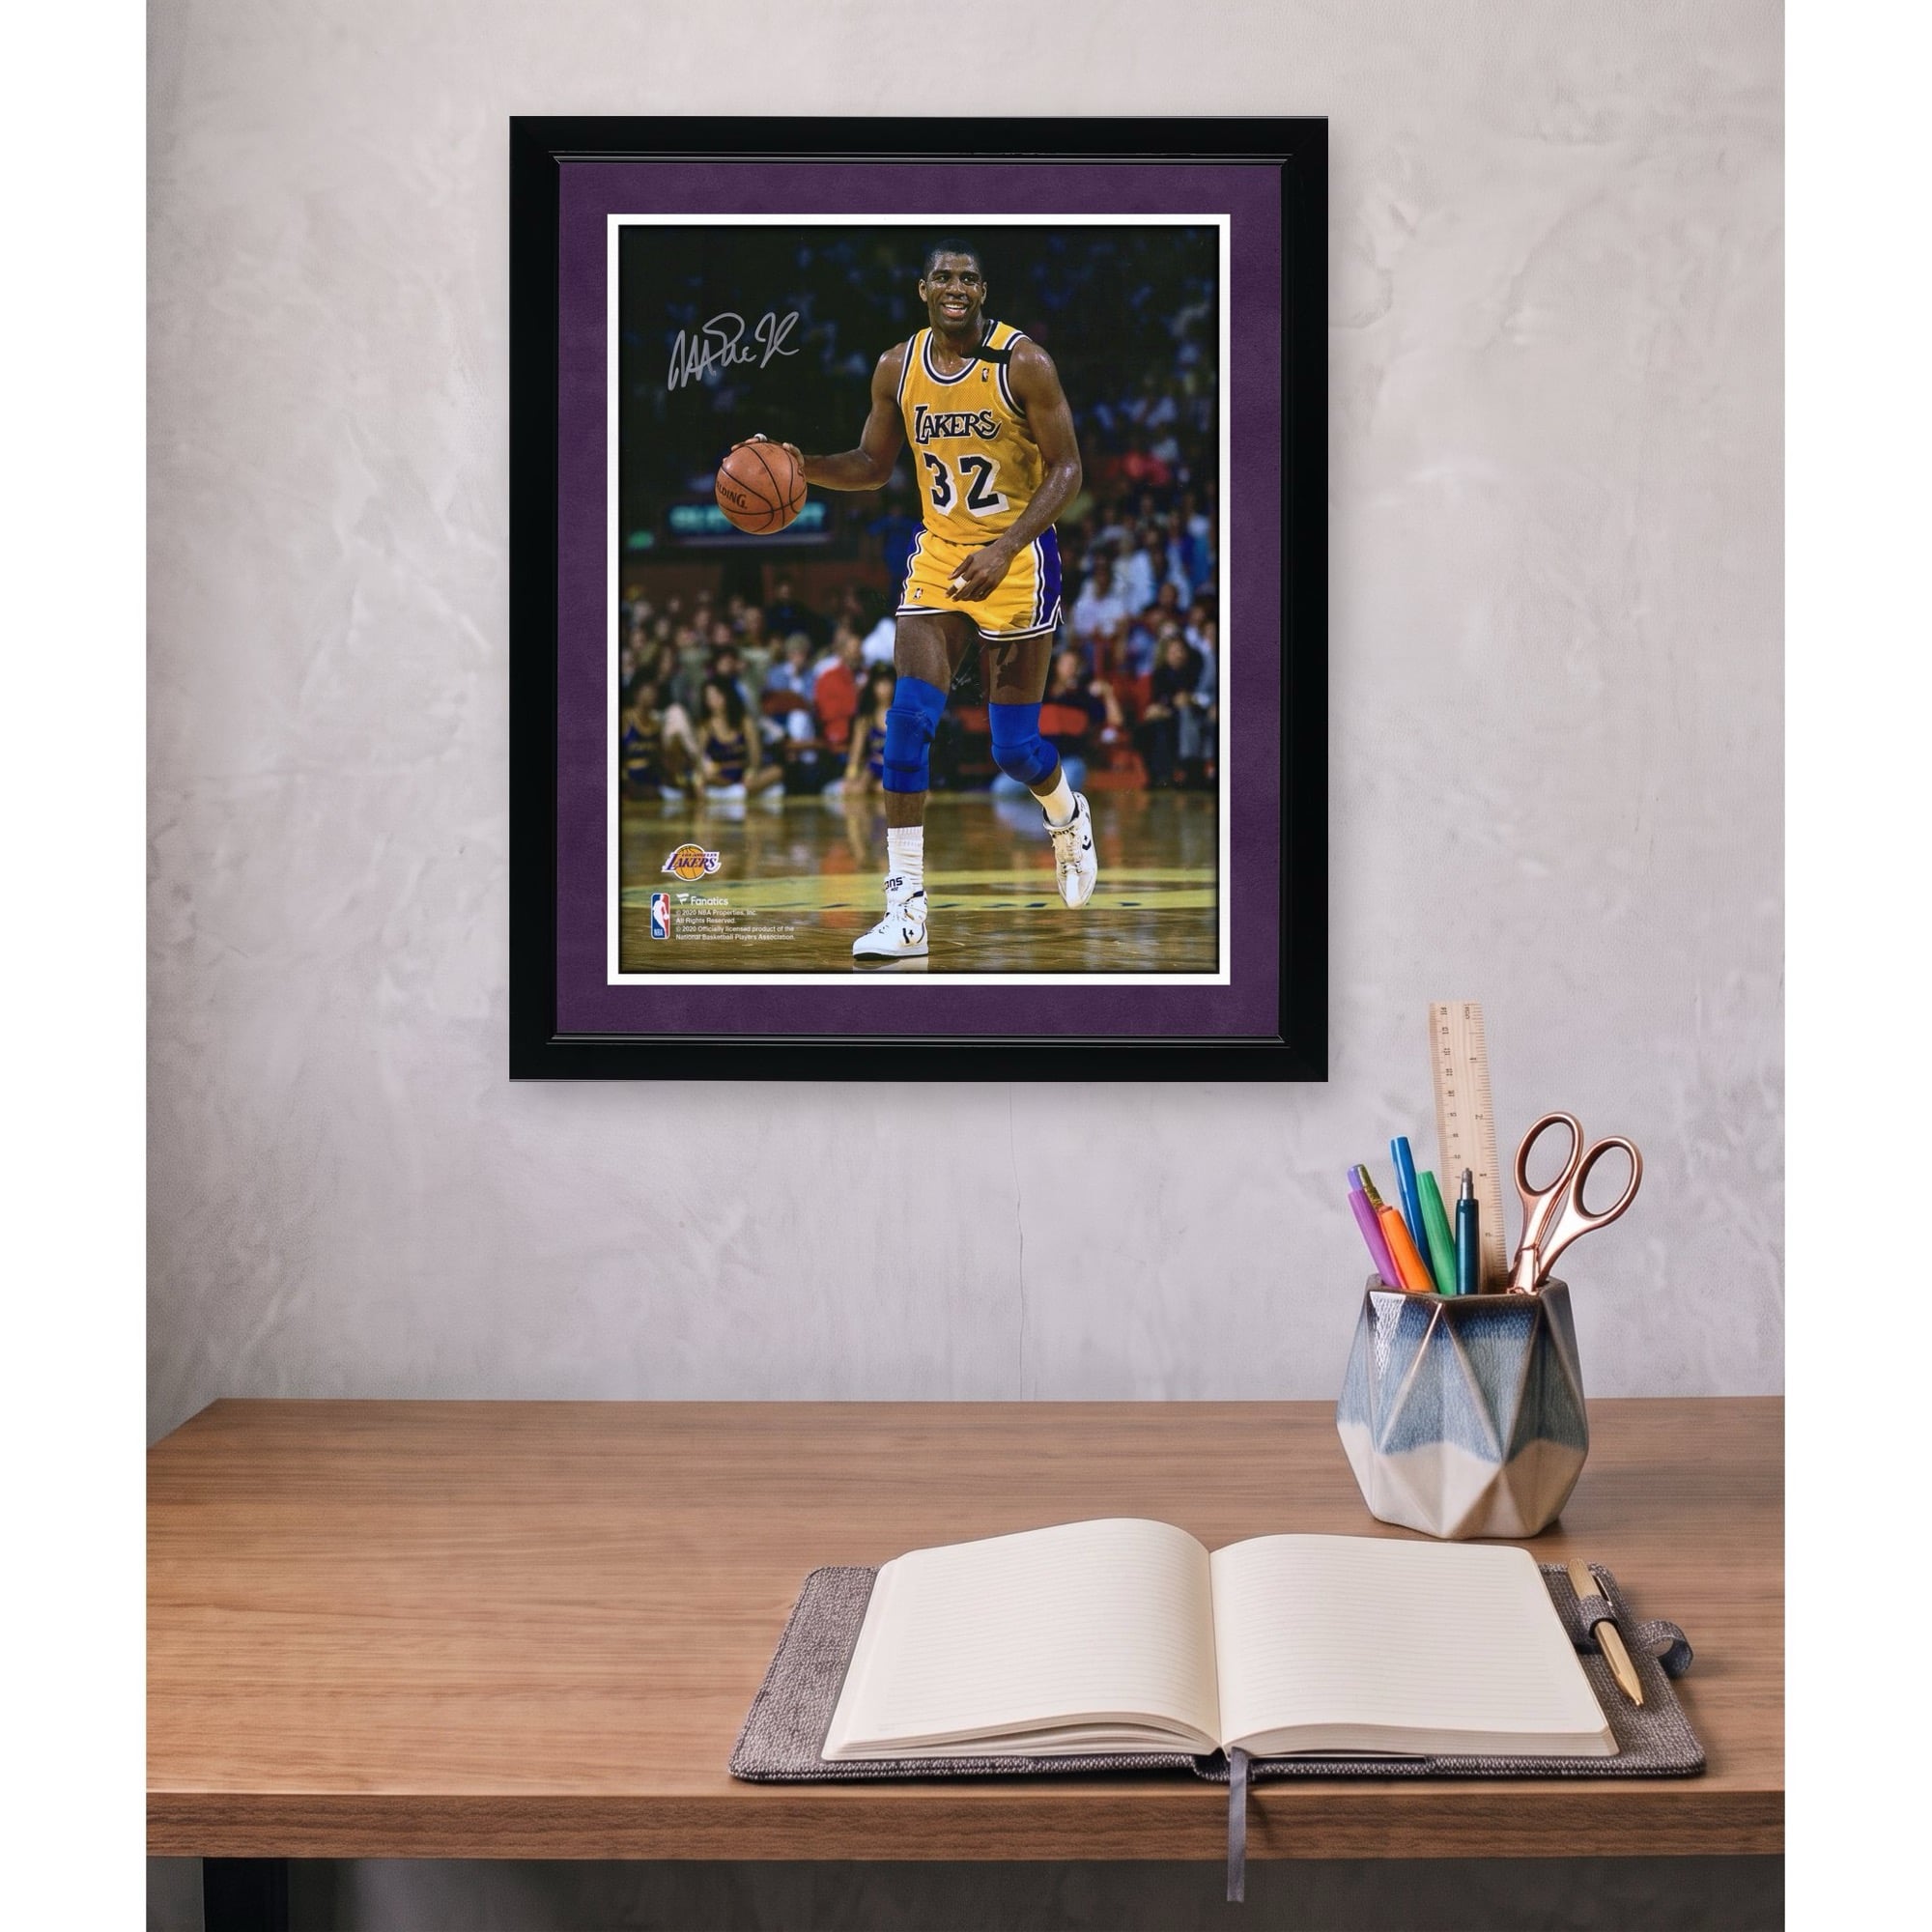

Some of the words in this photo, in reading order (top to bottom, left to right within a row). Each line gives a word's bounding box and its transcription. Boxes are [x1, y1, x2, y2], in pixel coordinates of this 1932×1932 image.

[915, 405, 1002, 444] LAKERS
[923, 452, 1009, 518] 32
[665, 854, 717, 872] LAKERS
[884, 876, 903, 890] ons
[691, 895, 728, 906] Fanatics
